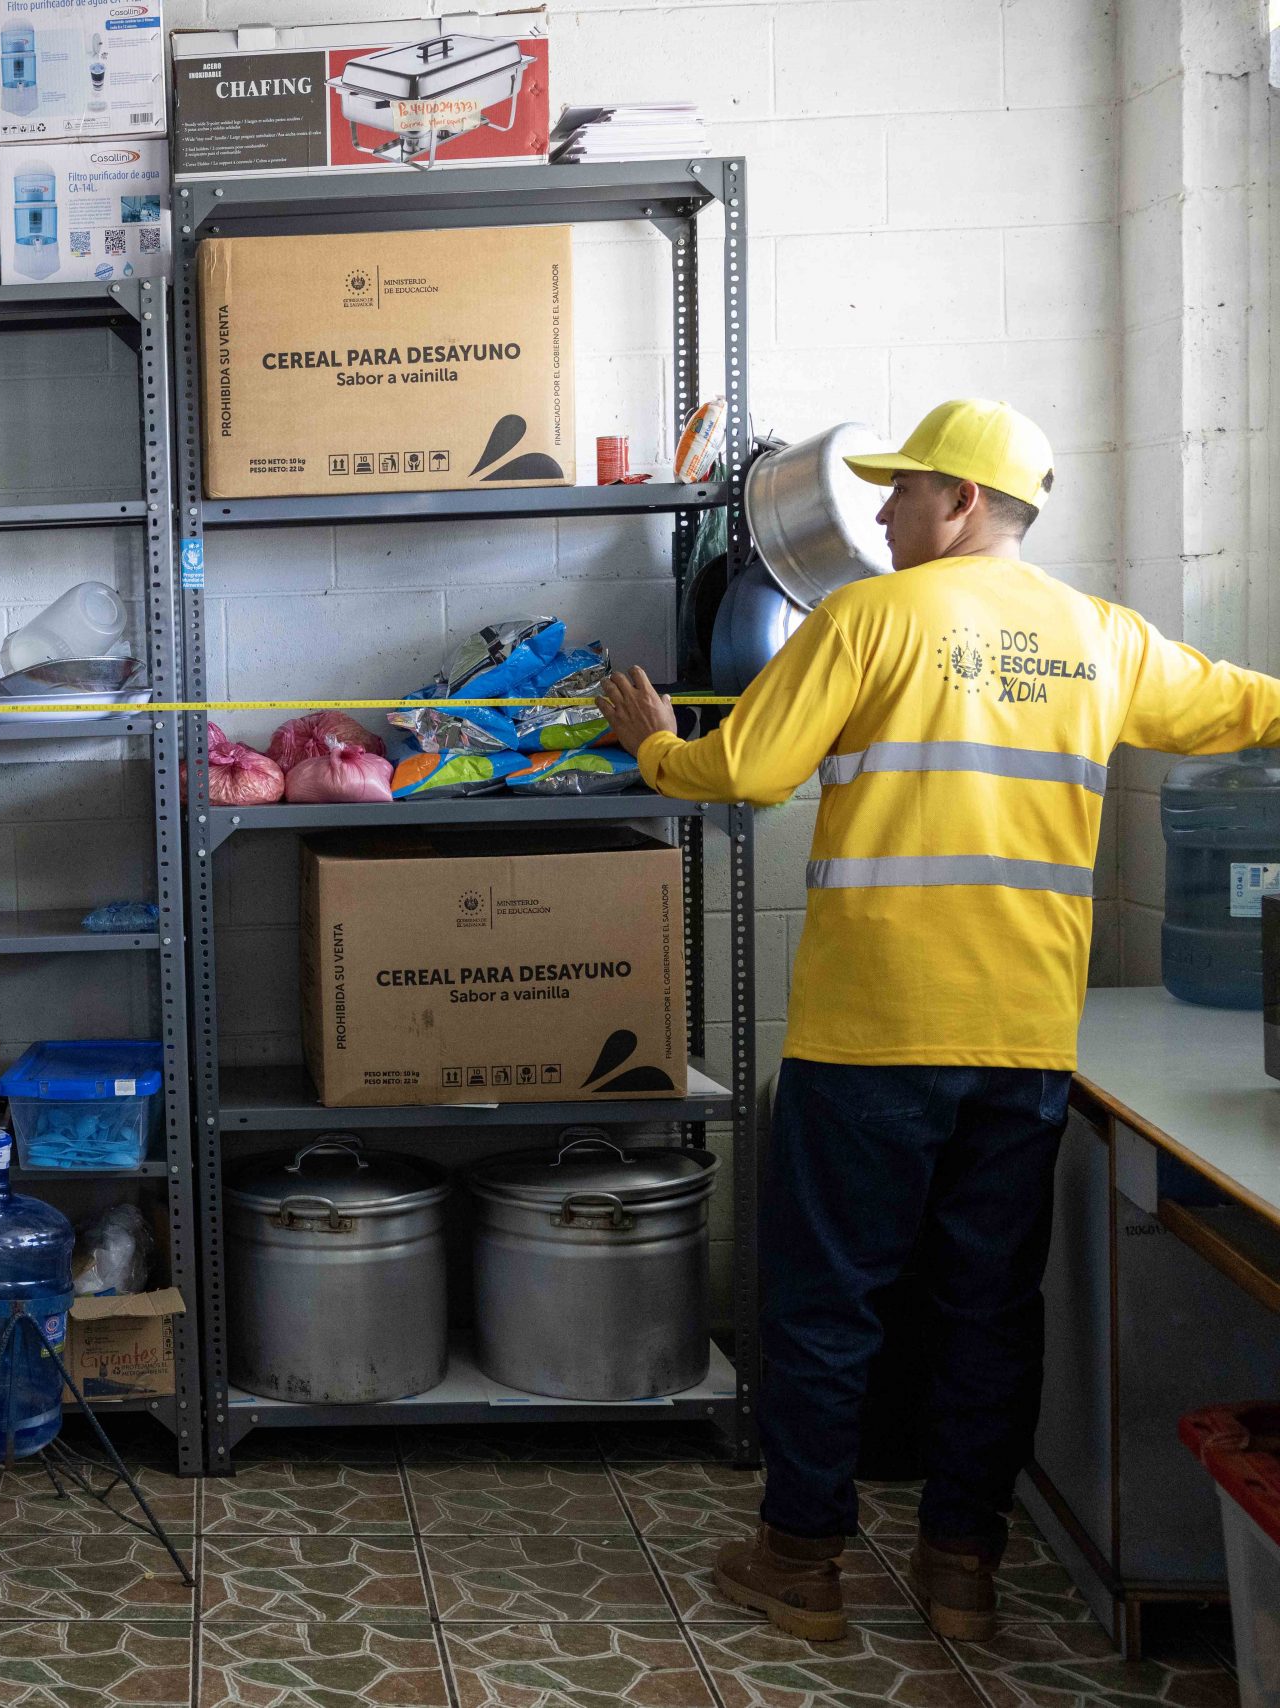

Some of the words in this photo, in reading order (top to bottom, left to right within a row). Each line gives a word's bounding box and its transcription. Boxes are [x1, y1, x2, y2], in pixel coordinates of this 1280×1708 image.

[7, 1, 29, 12] Filtro
[30, 0, 74, 11] purificador
[188, 71, 222, 79] INOXIDABLE
[215, 77, 313, 99] CHAFING
[68, 172, 88, 182] Filtro
[89, 171, 128, 183] purificador
[130, 171, 140, 180] de
[141, 170, 160, 181] agua
[383, 278, 426, 286] MINISTERIO
[395, 285, 439, 294] EDUCACIÓN
[219, 304, 229, 346] VENTA
[220, 349, 230, 365] SU
[263, 350, 342, 370] CEREAL
[347, 347, 401, 367] PARA
[407, 342, 521, 364] DESAYUNO
[337, 372, 383, 386] Sabor
[387, 374, 396, 384] a
[401, 368, 458, 383] vainilla
[220, 368, 232, 437] PROHIBIDA
[1001, 629, 1039, 654] DOS
[1001, 655, 1096, 681] ESCUELAS
[496, 899, 539, 907] MINISTERIO
[508, 905, 551, 915] EDUCACIÓN
[333, 923, 344, 962] VENTA
[335, 965, 345, 982] SU
[376, 969, 455, 987] CEREAL
[460, 967, 514, 985] PARA
[520, 960, 632, 982] DESAYUNO
[450, 989, 496, 1003] Sabor
[500, 991, 509, 1001] a
[513, 986, 570, 1000] vainilla
[336, 983, 346, 1050] PROHIBIDA
[80, 1342, 159, 1368] Guantes
